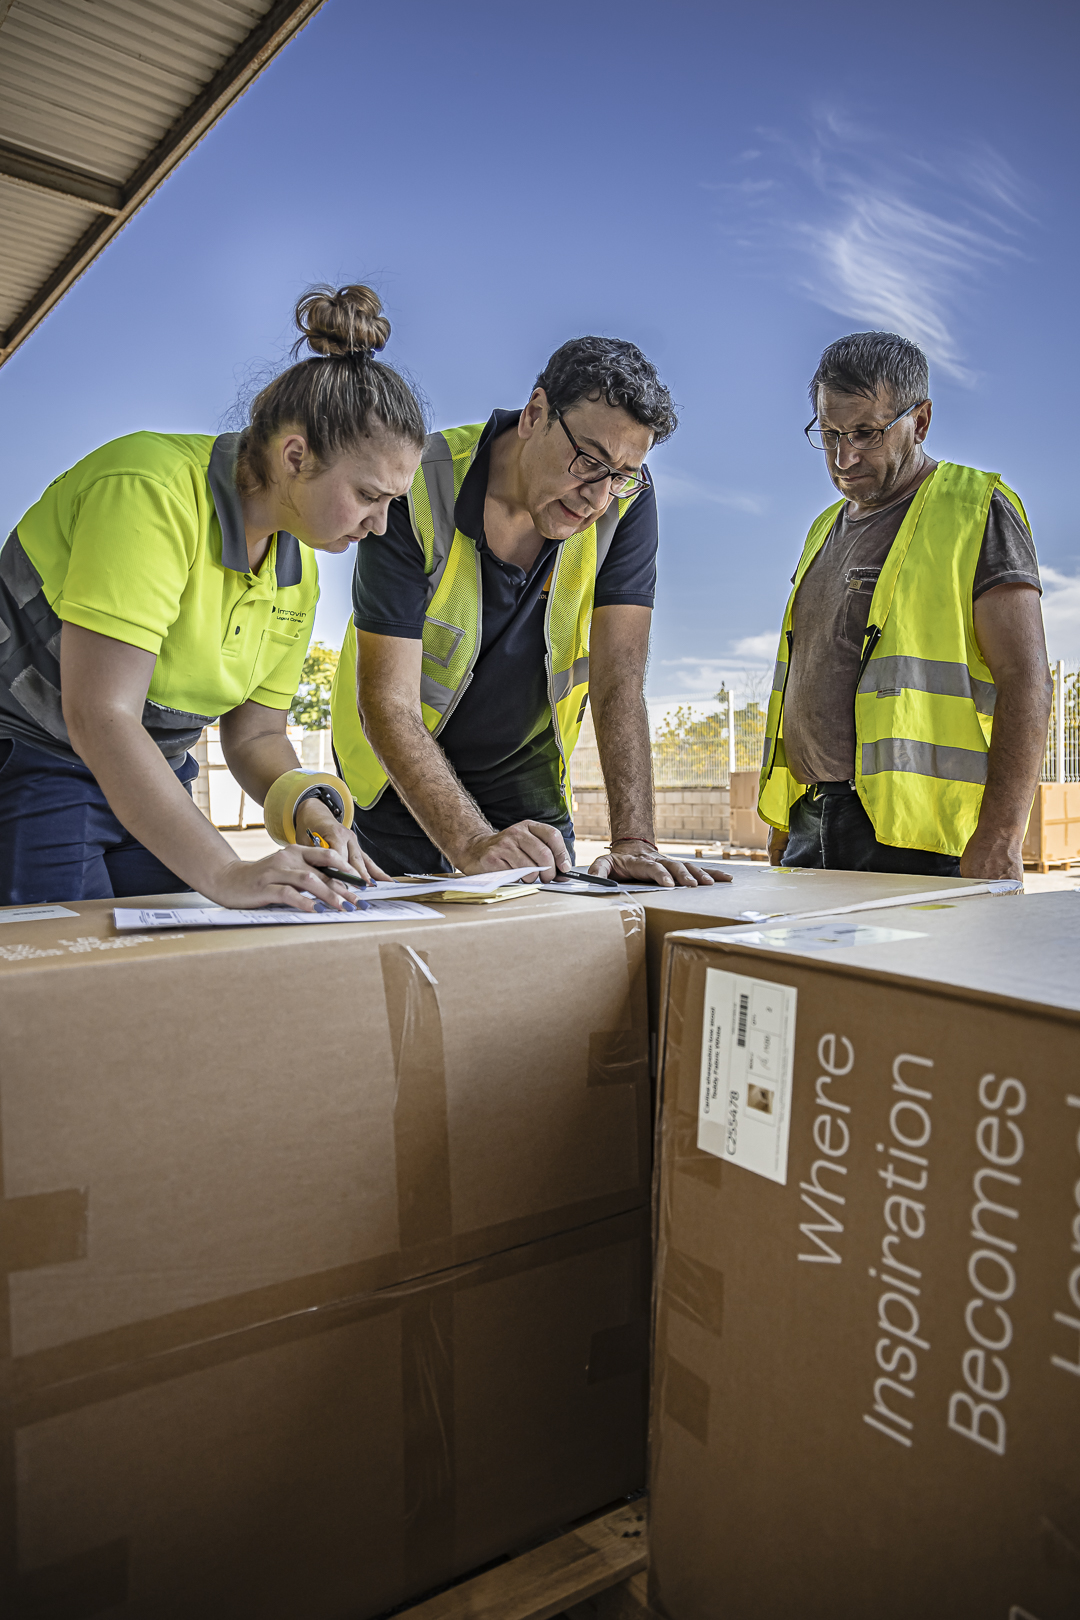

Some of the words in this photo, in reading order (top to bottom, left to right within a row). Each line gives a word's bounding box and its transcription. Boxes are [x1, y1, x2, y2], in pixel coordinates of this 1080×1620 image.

[797, 1032, 855, 1265] Where
[862, 1052, 935, 1448] Inspiration
[947, 1073, 1027, 1456] Becomes
